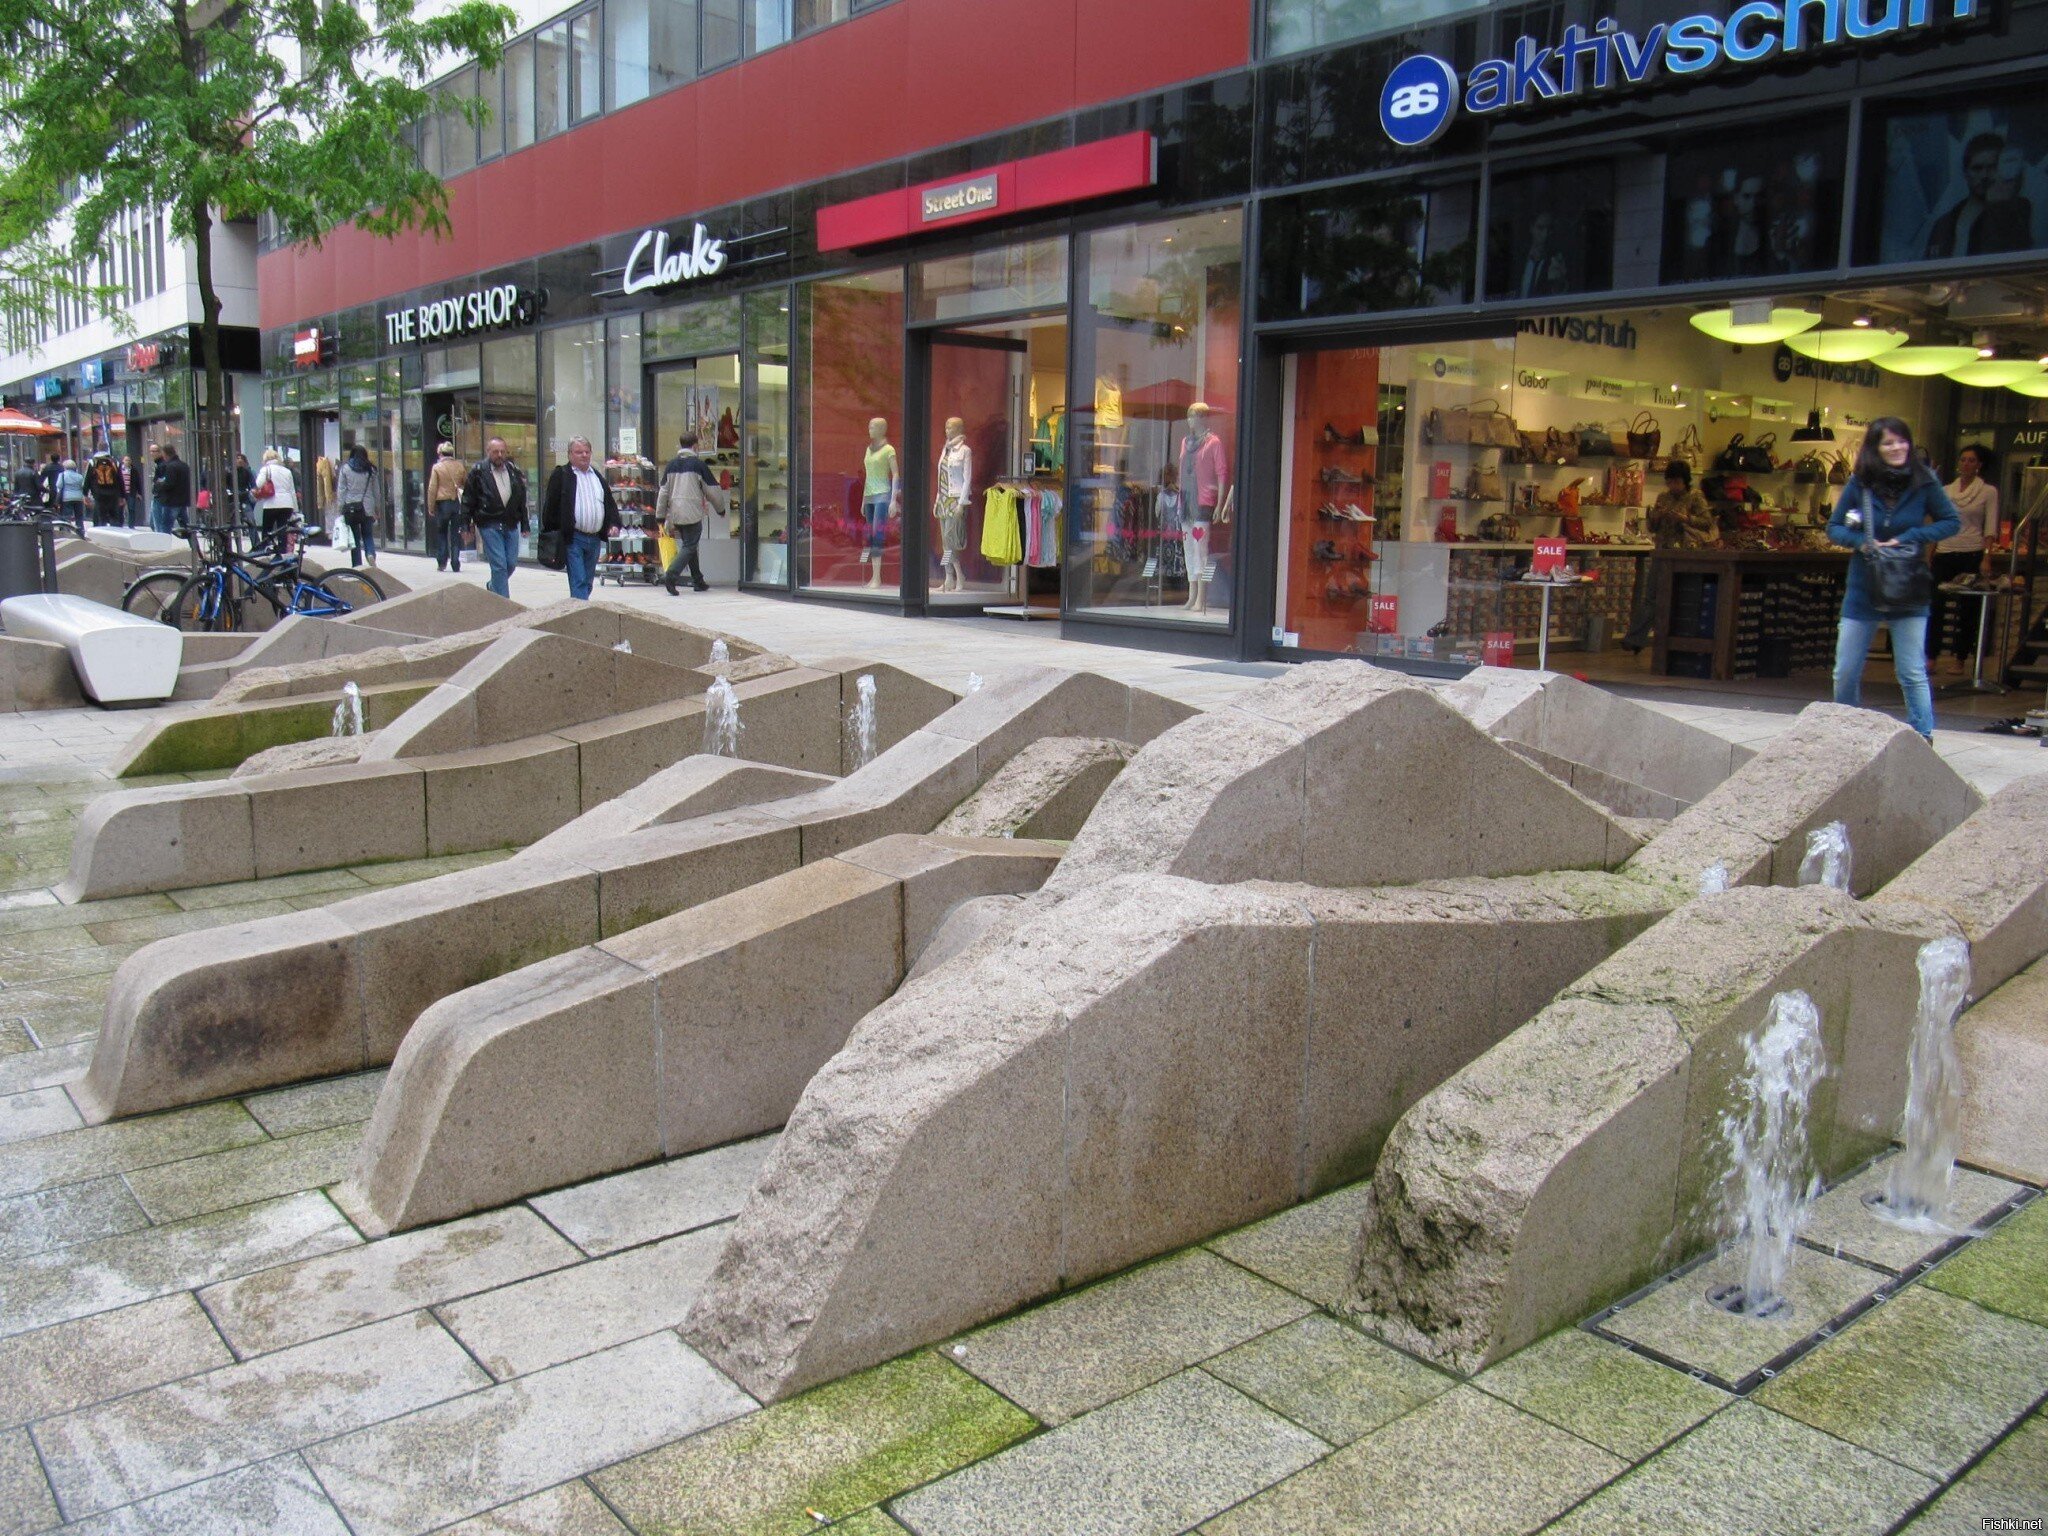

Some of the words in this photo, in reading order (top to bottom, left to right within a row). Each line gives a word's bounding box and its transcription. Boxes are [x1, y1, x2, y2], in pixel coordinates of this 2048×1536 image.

[926, 189, 965, 214] Street
[966, 186, 992, 205] One
[624, 222, 727, 295] Clarks
[386, 309, 415, 345] THE
[419, 296, 465, 338] BODY
[468, 284, 517, 329] SHOP
[1518, 370, 1550, 390] Gabor
[2013, 431, 2048, 444] AUF
[1536, 546, 1562, 556] SALE
[1374, 601, 1395, 611] SALE
[1487, 640, 1510, 650] SALE
